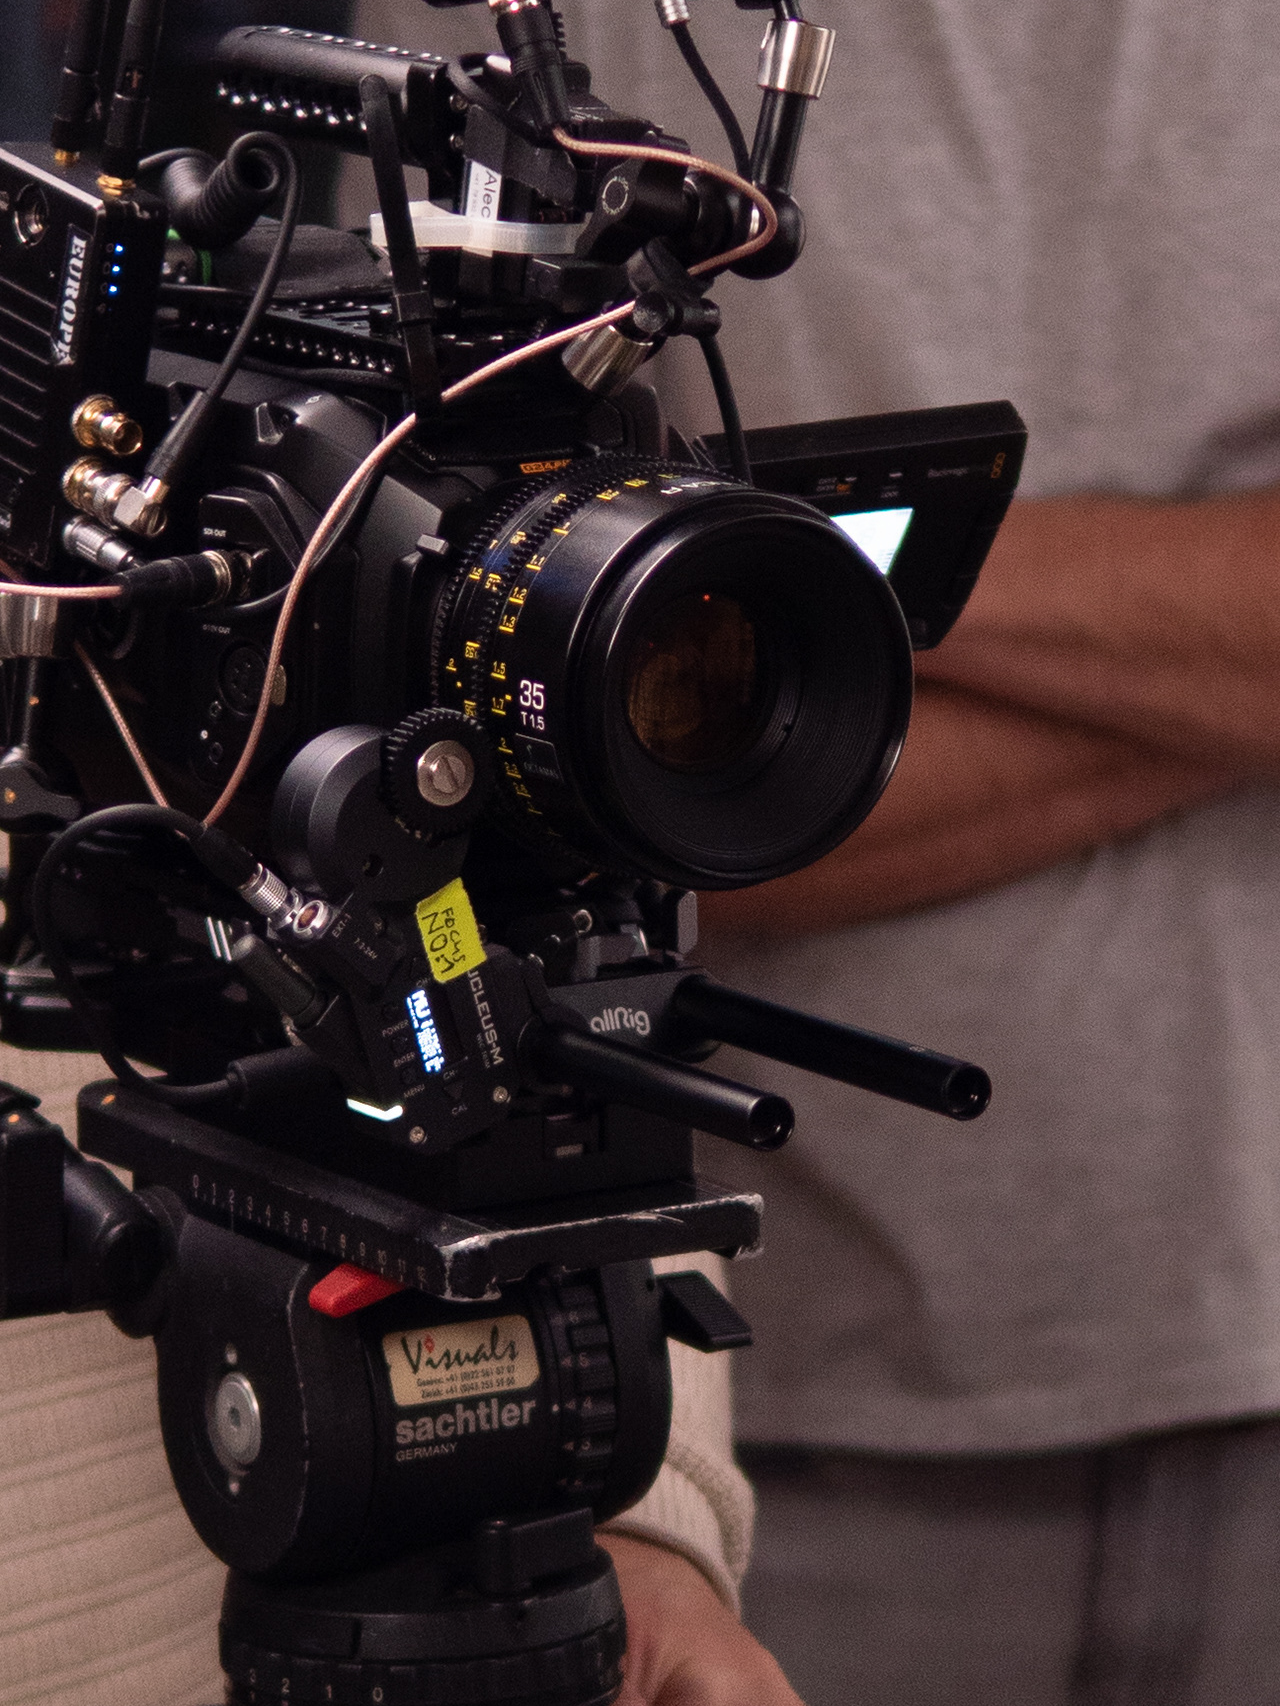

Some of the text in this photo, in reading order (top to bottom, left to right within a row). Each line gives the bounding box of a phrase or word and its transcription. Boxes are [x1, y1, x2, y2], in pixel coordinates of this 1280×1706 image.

[56, 236, 86, 366] EUROPE
[493, 660, 507, 675] 1.5
[492, 697, 505, 710] 1.7
[519, 679, 545, 710] 35
[382, 1019, 409, 1038] POWER
[467, 970, 505, 1067] UCLEUS-M
[590, 1006, 651, 1036] allRig
[451, 1104, 469, 1117] CAL
[192, 1174, 200, 1190] 0
[211, 1182, 217, 1195] 1
[228, 1189, 235, 1204] 2
[377, 1250, 387, 1266] 10
[401, 1325, 519, 1376] Visuals
[582, 1396, 593, 1410] 4
[395, 1398, 537, 1445] sachtler
[395, 1441, 458, 1462] GERMANY
[281, 1677, 290, 1694] 2
[325, 1683, 333, 1700] 1
[371, 1686, 384, 1703] 0
